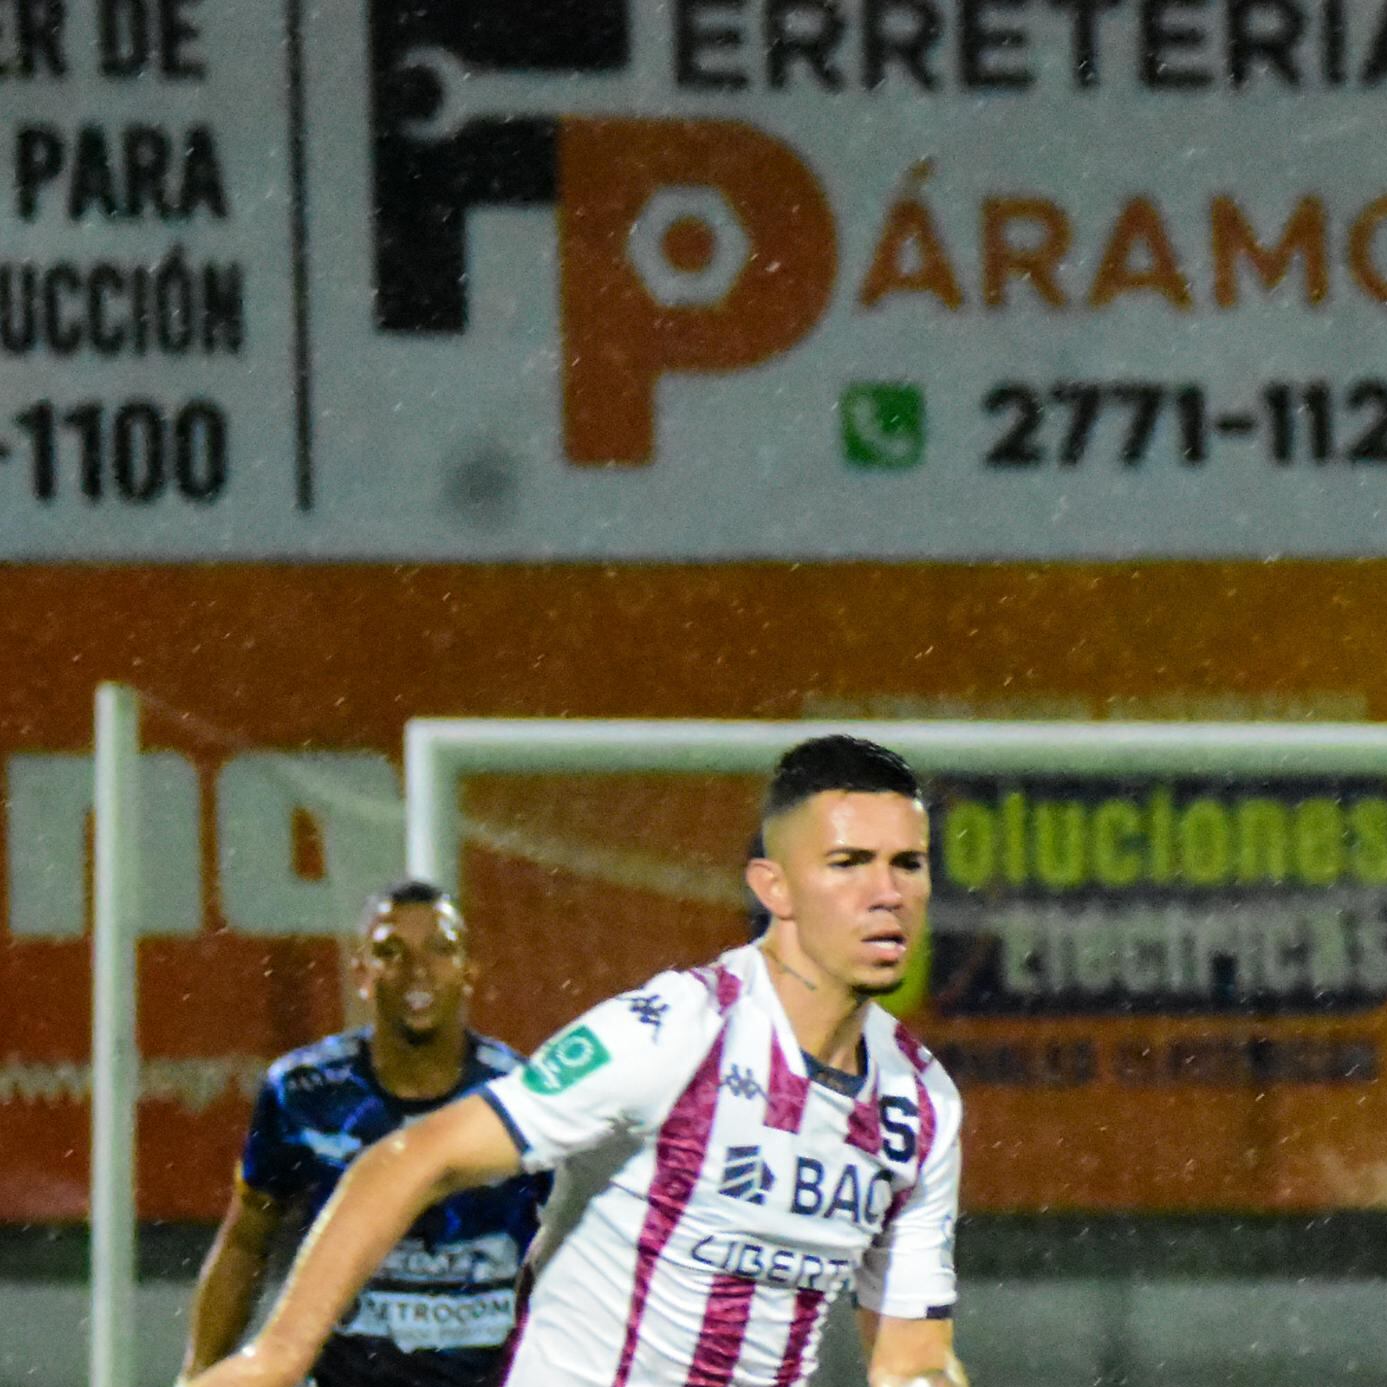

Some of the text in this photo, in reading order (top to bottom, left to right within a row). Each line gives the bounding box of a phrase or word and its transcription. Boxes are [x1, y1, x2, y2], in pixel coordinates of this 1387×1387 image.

[0, 0, 207, 80] R DE
[15, 121, 229, 222] PARA
[880, 1095, 917, 1164] S
[790, 1156, 894, 1228] BAC
[690, 1234, 856, 1291] LIBERT
